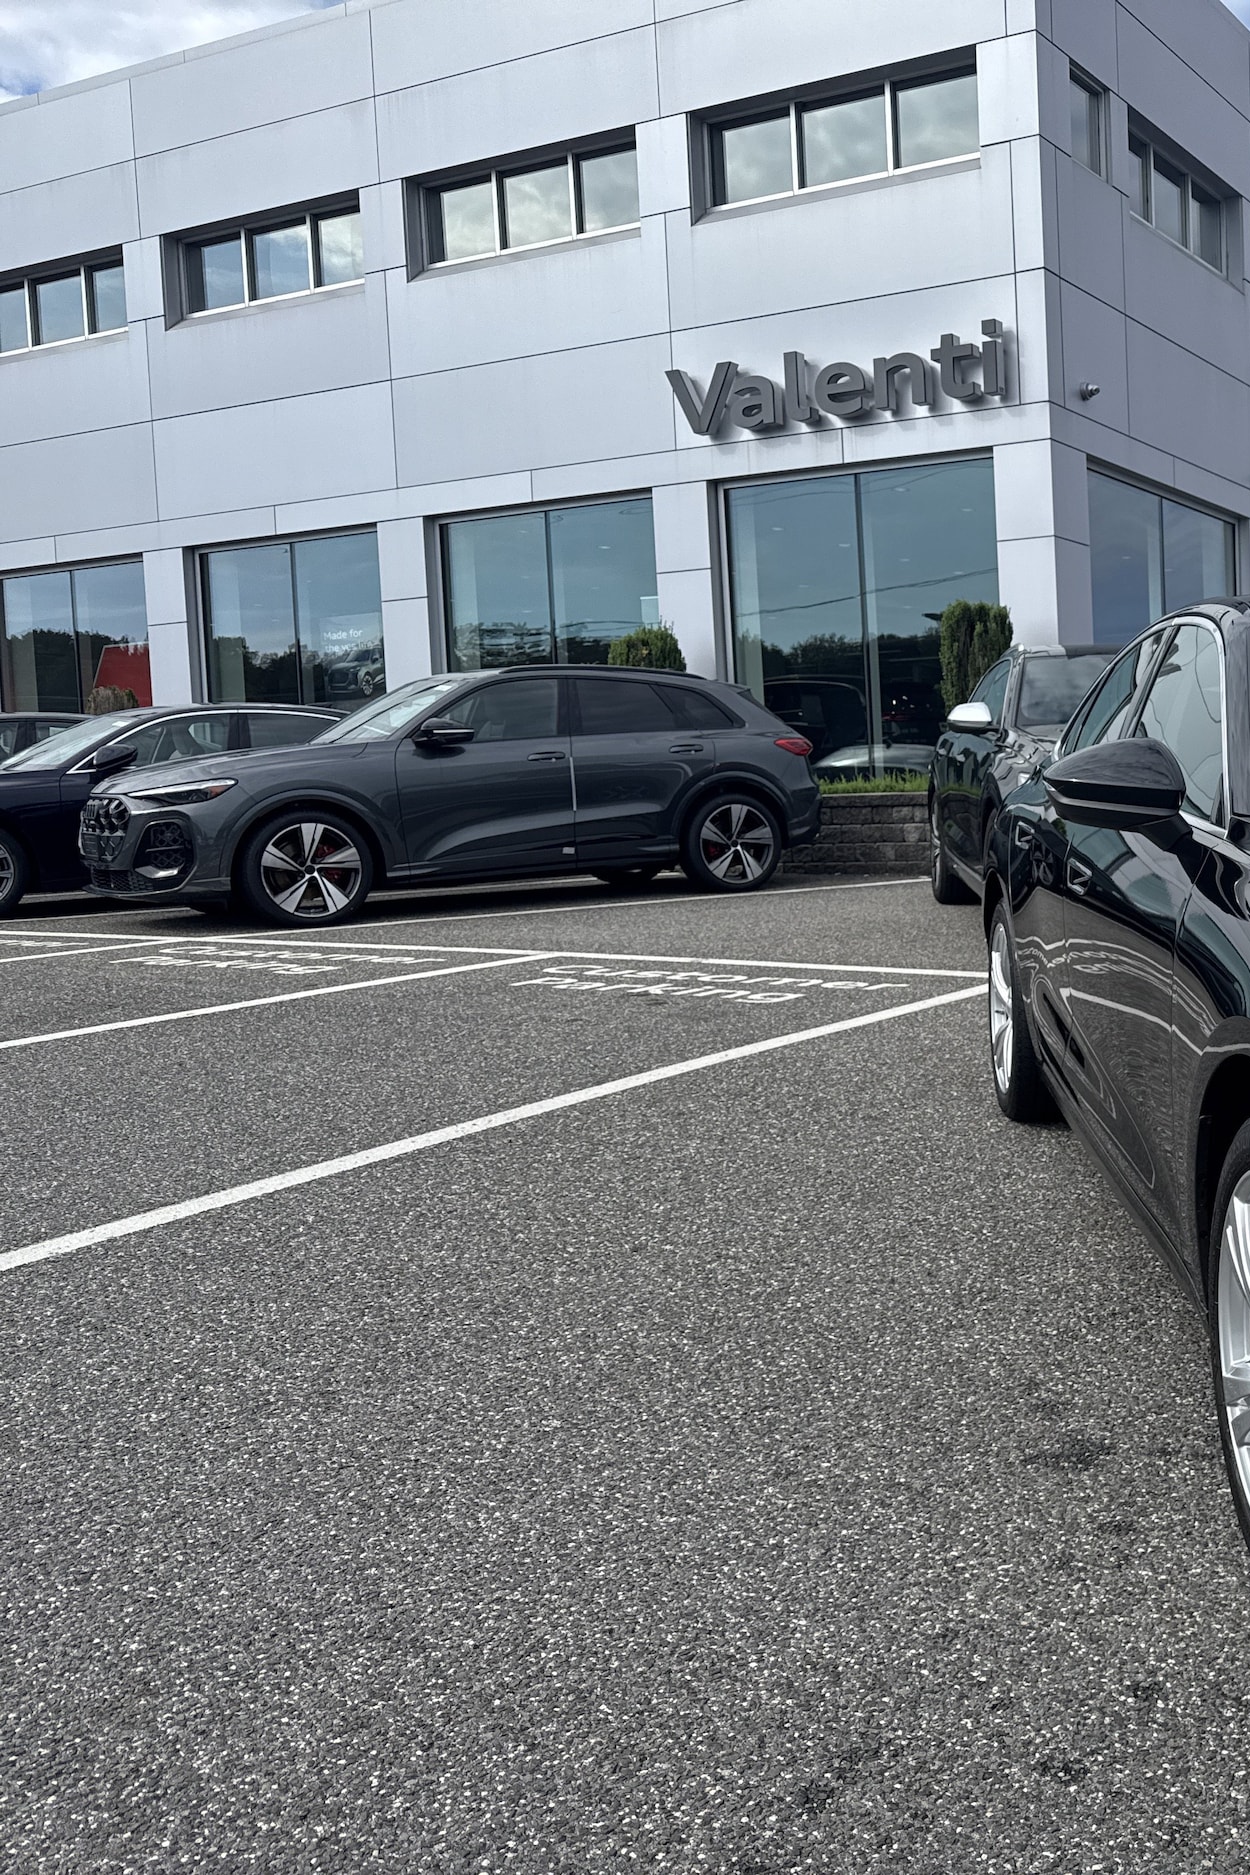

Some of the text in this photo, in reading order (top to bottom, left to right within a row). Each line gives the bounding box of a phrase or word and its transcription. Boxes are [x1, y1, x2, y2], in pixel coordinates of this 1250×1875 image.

[665, 319, 1004, 435] Valenti
[323, 629, 363, 641] Made for
[325, 643, 341, 653] the
[109, 955, 343, 975] Parking
[159, 946, 447, 964] Customer
[542, 964, 909, 991] Customer
[510, 976, 806, 1004] Parking
